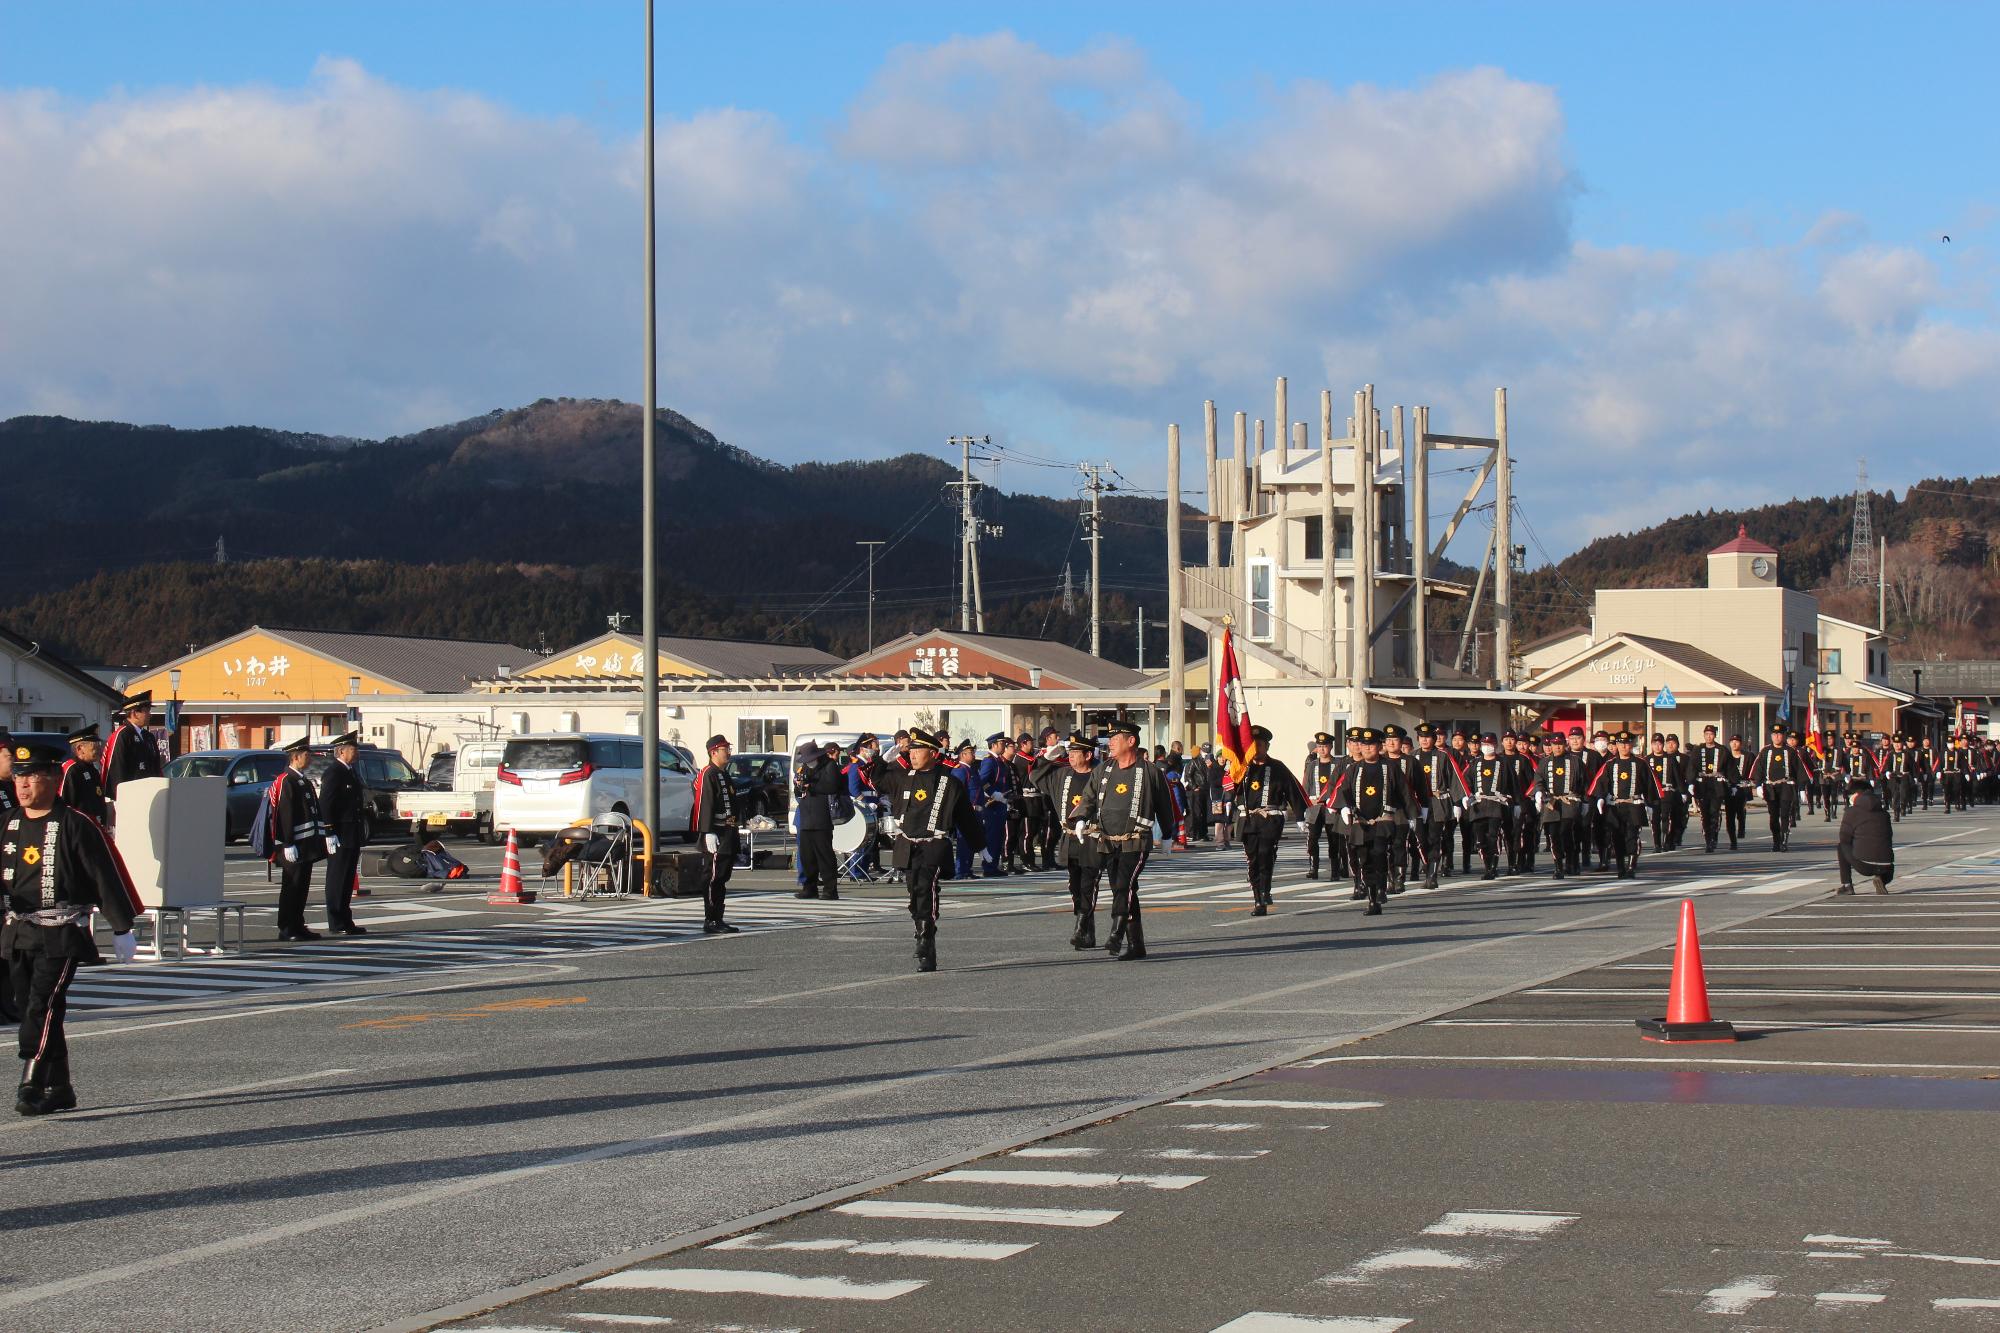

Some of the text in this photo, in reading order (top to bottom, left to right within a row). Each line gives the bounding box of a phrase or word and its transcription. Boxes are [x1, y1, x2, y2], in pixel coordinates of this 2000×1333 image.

[223, 655, 291, 676] いわ井
[1588, 655, 1657, 673] Kankyu
[246, 677, 267, 687] 1747
[1608, 673, 1637, 685] 1896
[41, 821, 60, 907] 陸前高田市消防団
